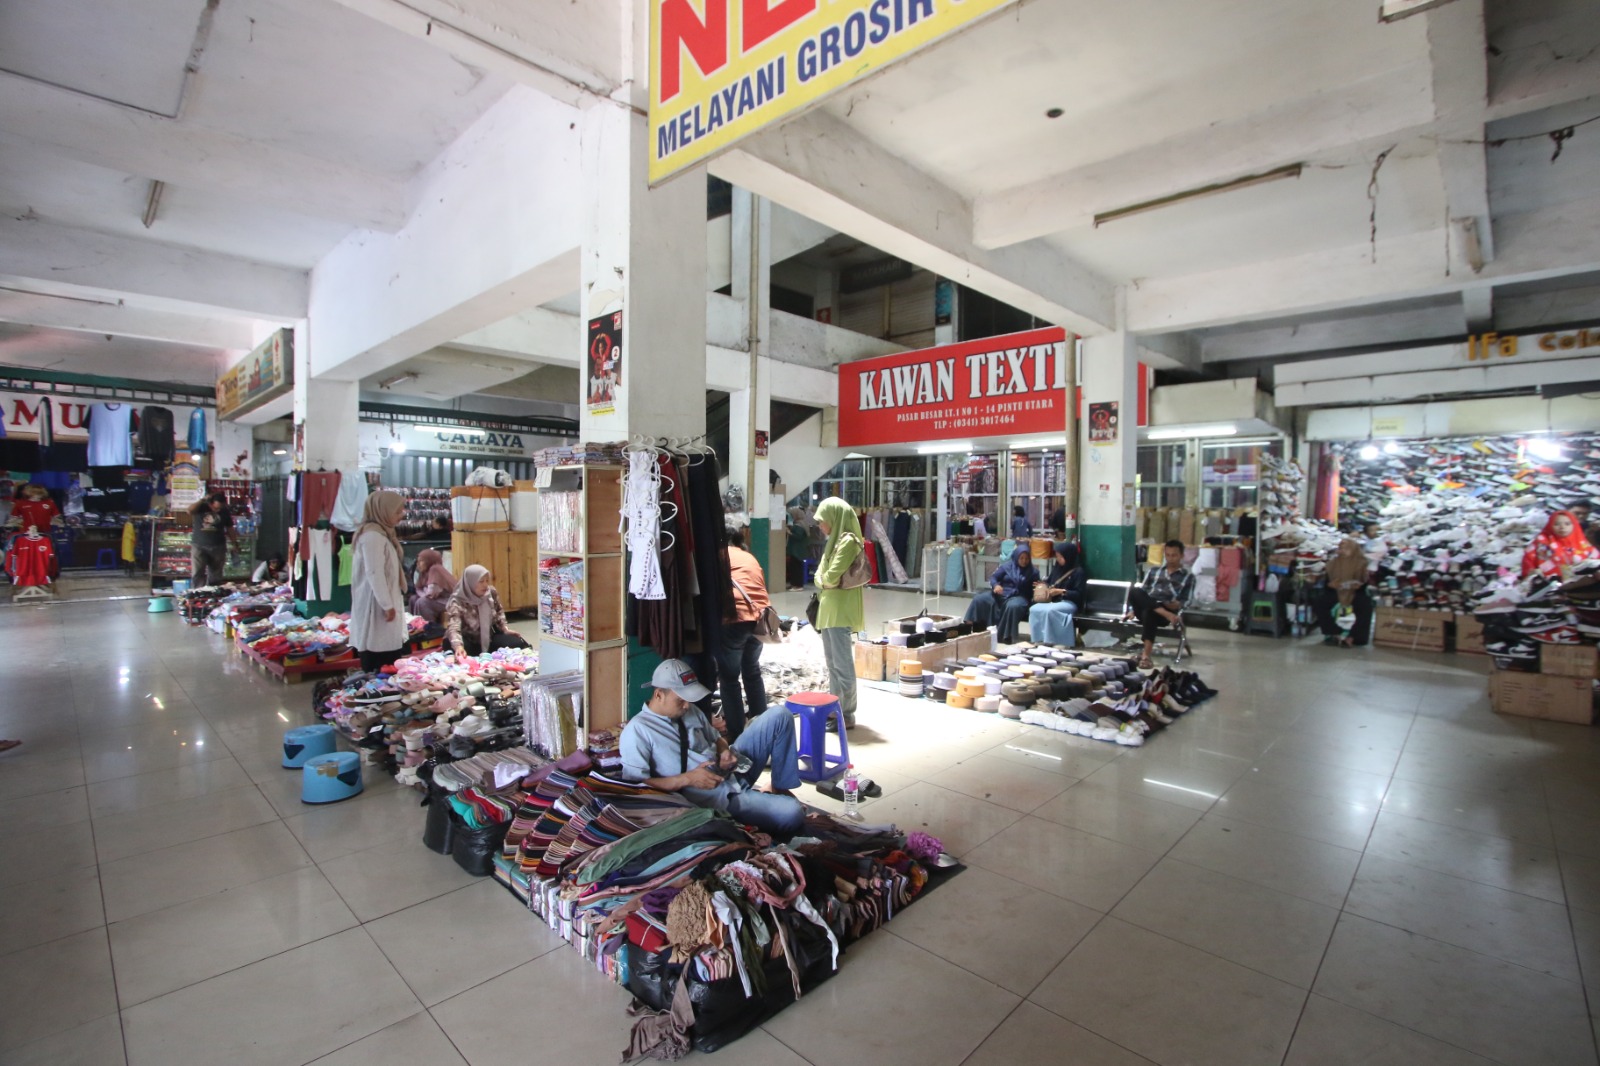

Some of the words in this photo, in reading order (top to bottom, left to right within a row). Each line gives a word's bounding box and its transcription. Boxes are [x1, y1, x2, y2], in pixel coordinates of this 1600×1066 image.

[657, 55, 785, 159] MELAYANI
[858, 357, 956, 411] KAWAN
[965, 339, 1083, 398] TEXTI
[897, 412, 919, 422] PASAR
[920, 410, 943, 420] BESAR
[961, 407, 972, 416] NO
[986, 404, 995, 414] 14
[997, 402, 1023, 412] PINTU
[1025, 398, 1054, 410] UTARA
[934, 420, 947, 429] TLP
[953, 417, 979, 428] (0341)
[980, 414, 1015, 425] 3017464
